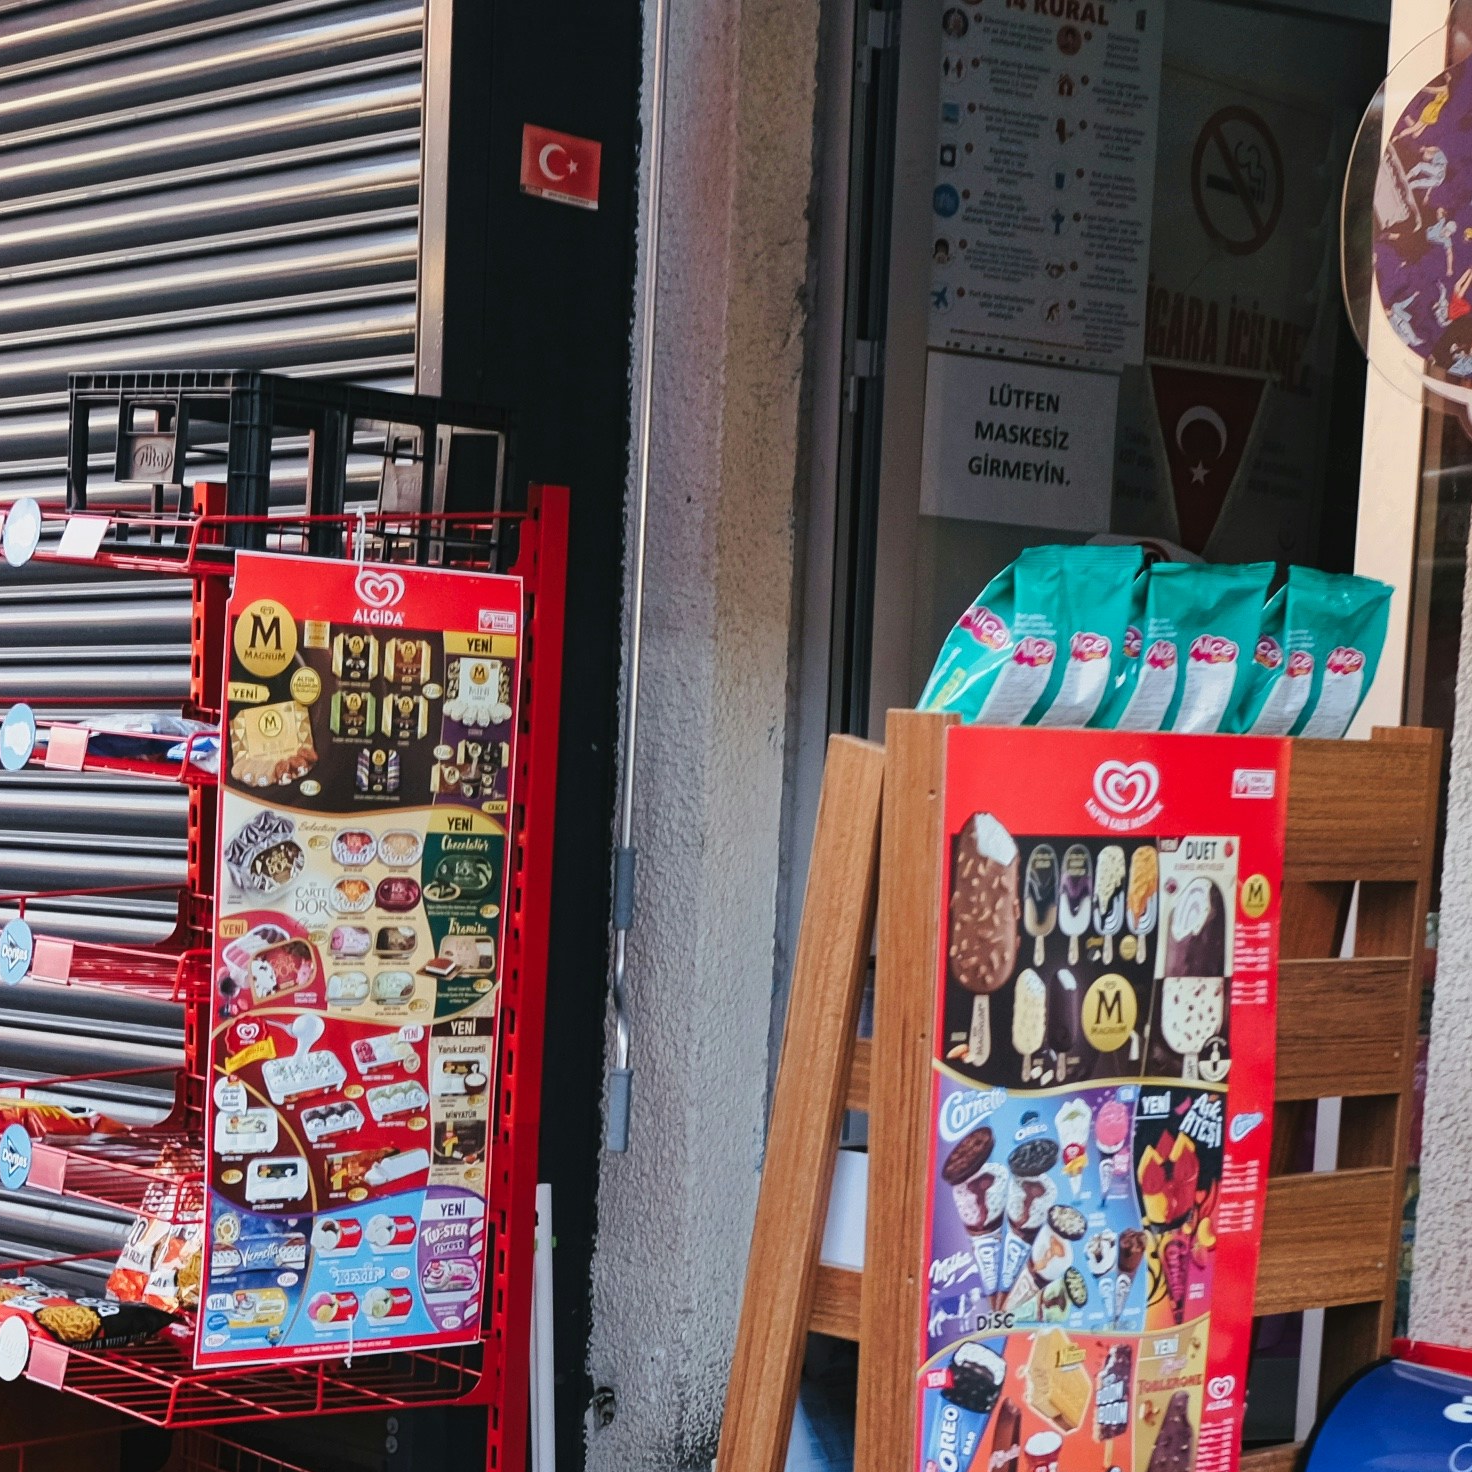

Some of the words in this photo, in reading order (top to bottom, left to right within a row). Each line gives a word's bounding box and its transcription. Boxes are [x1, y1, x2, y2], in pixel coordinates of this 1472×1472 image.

[989, 384, 1061, 414] LÜTFEN
[974, 420, 1070, 451] MASKESİZ
[968, 454, 1071, 487] GİRMEYİN.
[467, 637, 493, 653] YENİ
[244, 649, 286, 661] MAGNUM
[233, 686, 258, 699] YENİ
[447, 815, 473, 832] YENİ
[1185, 841, 1217, 860] DUET
[295, 886, 328, 899] CARTE
[222, 922, 244, 935] YENİ
[403, 1028, 419, 1041] YENİ
[451, 1018, 477, 1036] YENİ
[2, 1147, 28, 1169] Doritos
[440, 1202, 465, 1217] YENİ
[210, 1295, 228, 1308] YENİ
